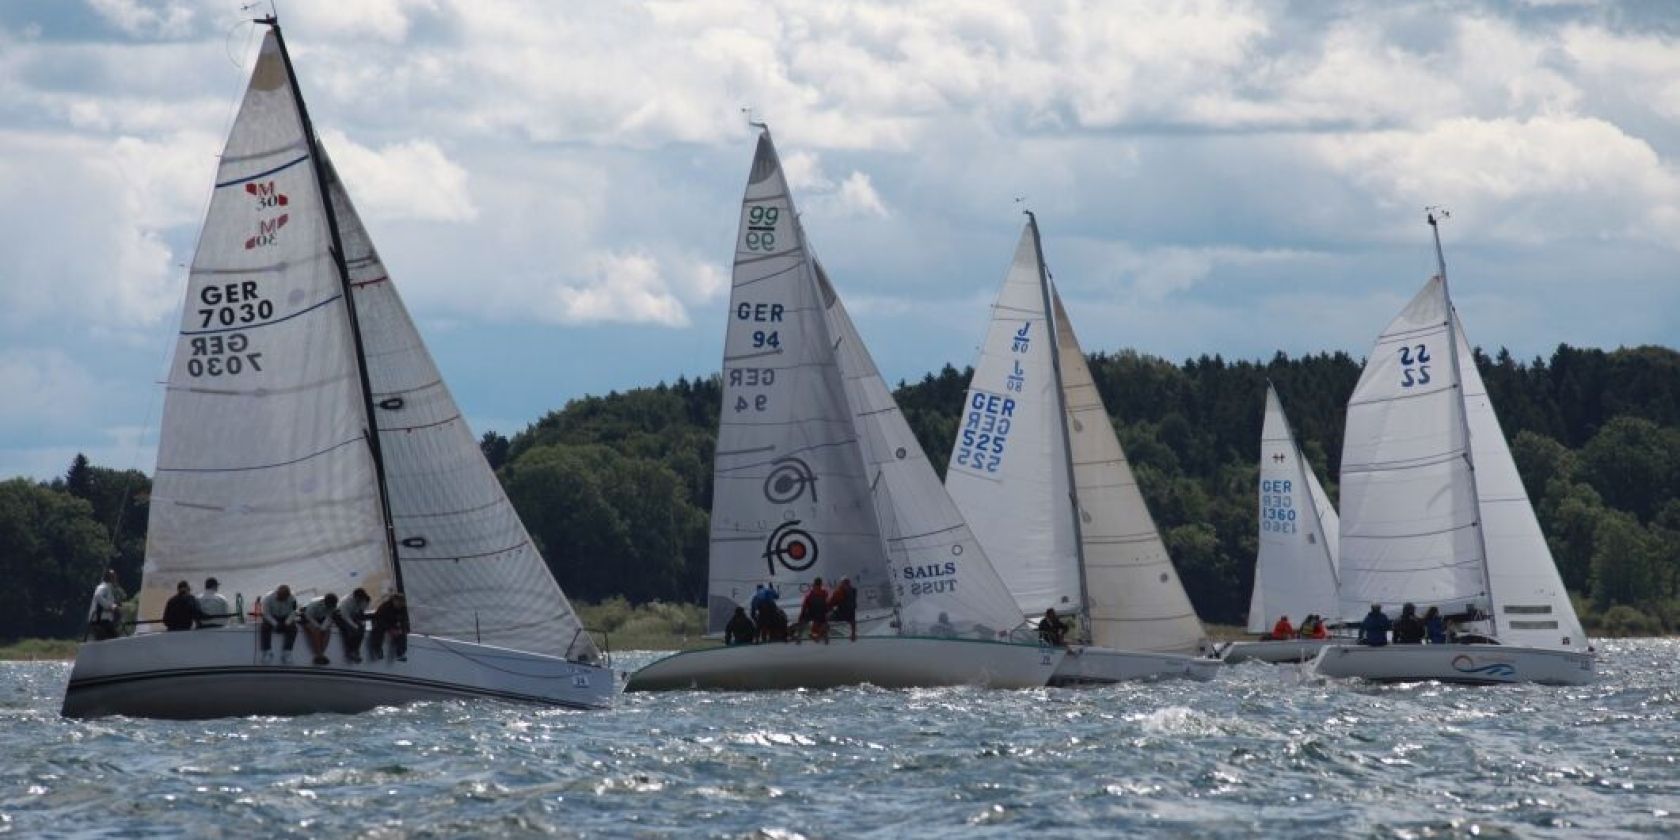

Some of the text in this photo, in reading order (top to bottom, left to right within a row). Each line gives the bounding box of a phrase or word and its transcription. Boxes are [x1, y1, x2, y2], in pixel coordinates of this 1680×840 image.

[258, 181, 275, 196] M
[255, 195, 278, 211] 30
[201, 281, 259, 305] GER
[198, 300, 274, 328] 7030
[737, 302, 785, 322] GER
[752, 330, 780, 348] 94
[1398, 344, 1430, 366] 22
[972, 392, 1016, 417] GER
[963, 429, 1006, 454] 525
[1263, 480, 1292, 493] GER
[1263, 506, 1296, 521] 1360
[903, 562, 956, 579] SAILS
